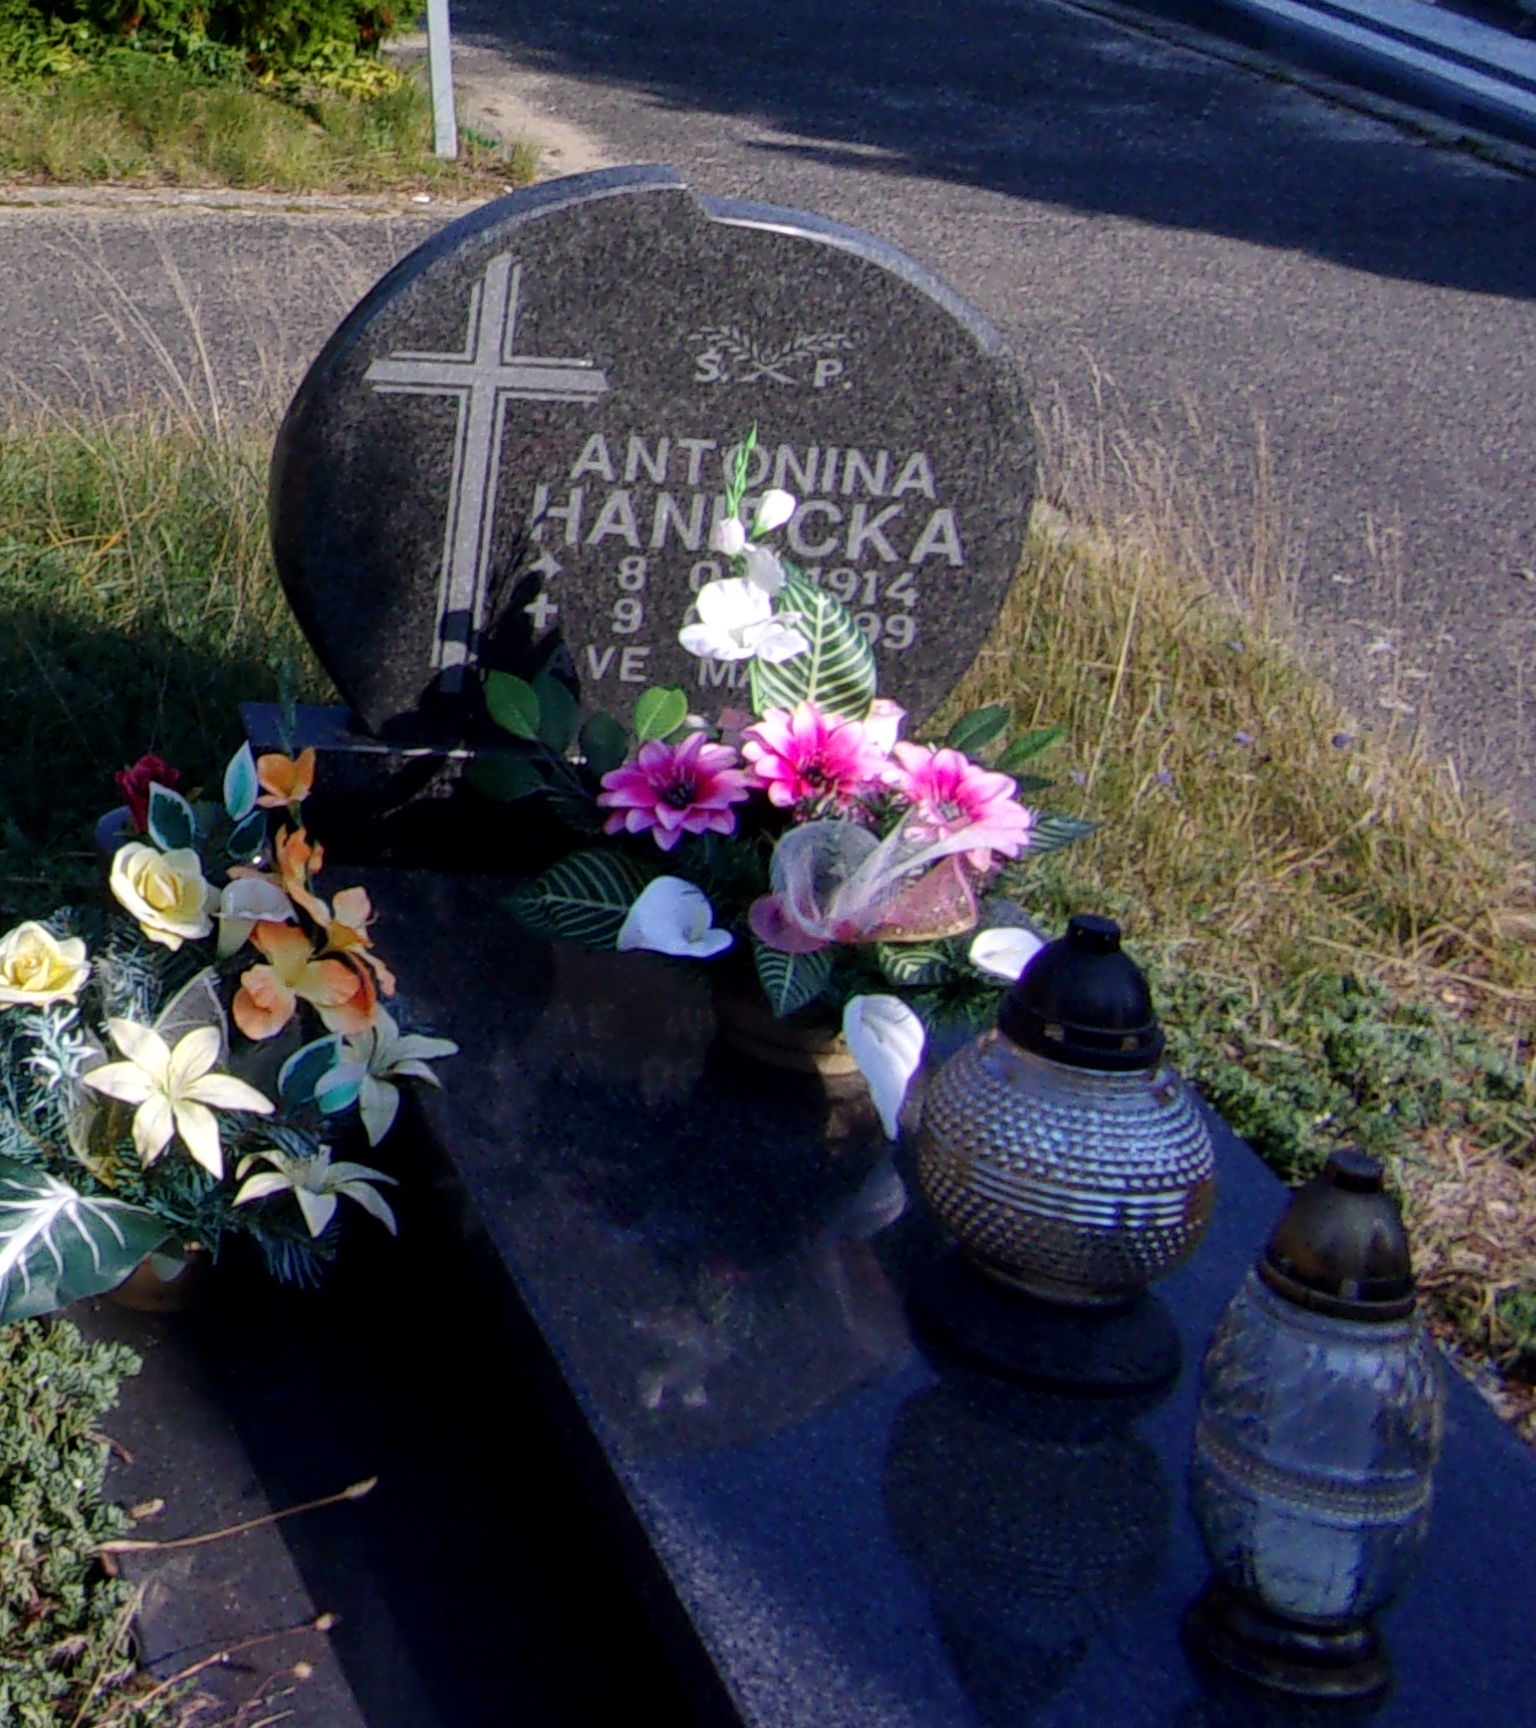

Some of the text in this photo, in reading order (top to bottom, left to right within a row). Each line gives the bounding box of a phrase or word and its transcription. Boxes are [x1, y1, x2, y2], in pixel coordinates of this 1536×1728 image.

[569, 432, 937, 500] ANTONINA
[618, 554, 648, 592] 8
[611, 597, 644, 635] 9
